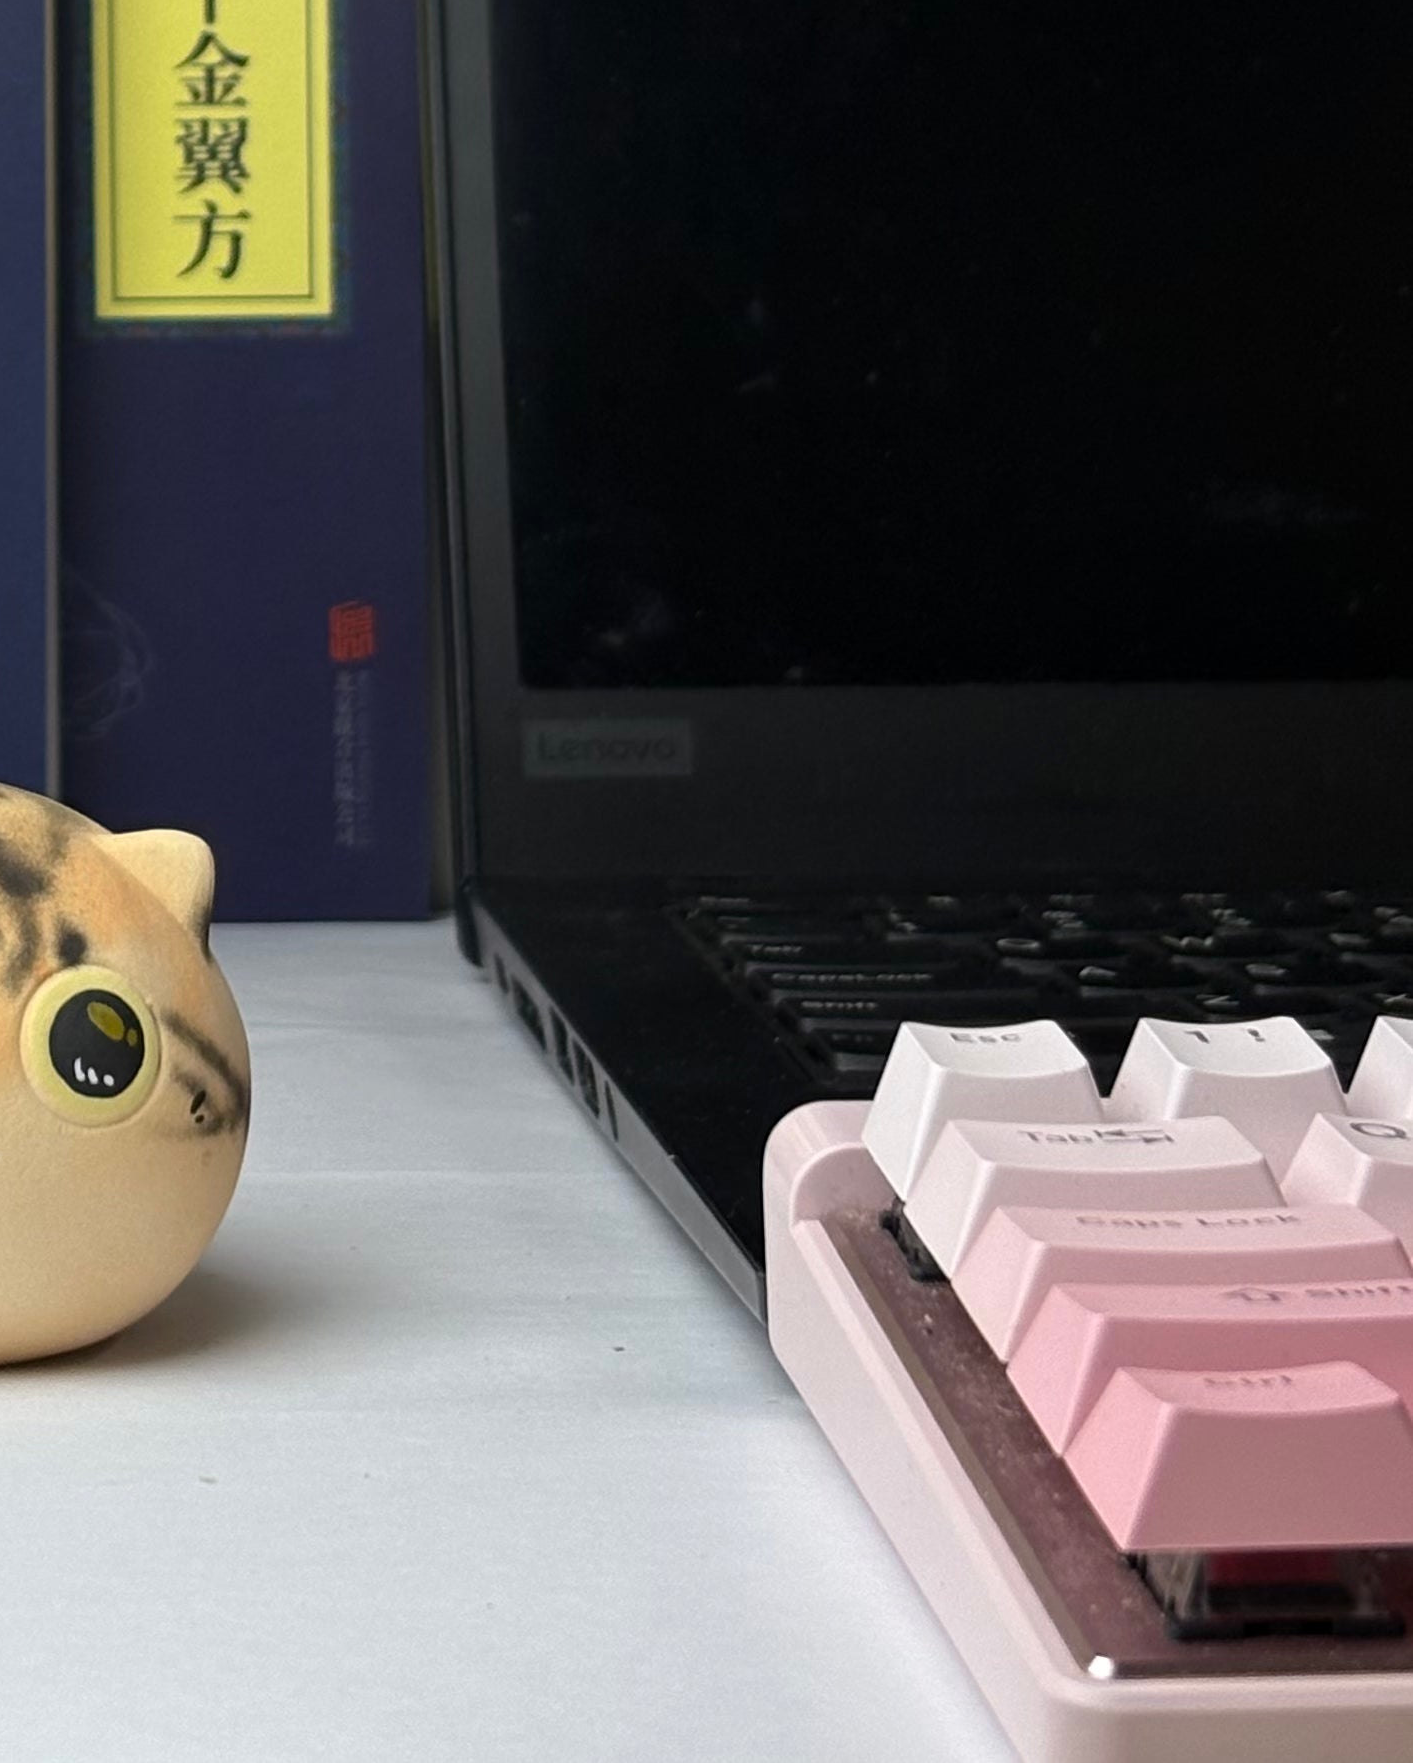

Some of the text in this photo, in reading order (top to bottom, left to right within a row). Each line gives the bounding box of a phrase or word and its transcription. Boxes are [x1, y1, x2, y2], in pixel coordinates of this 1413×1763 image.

[537, 731, 676, 762] Lenovo
[949, 1031, 1022, 1045] Esc
[1017, 1128, 1094, 1144] Tab
[1075, 1212, 1302, 1229] Caps Lock
